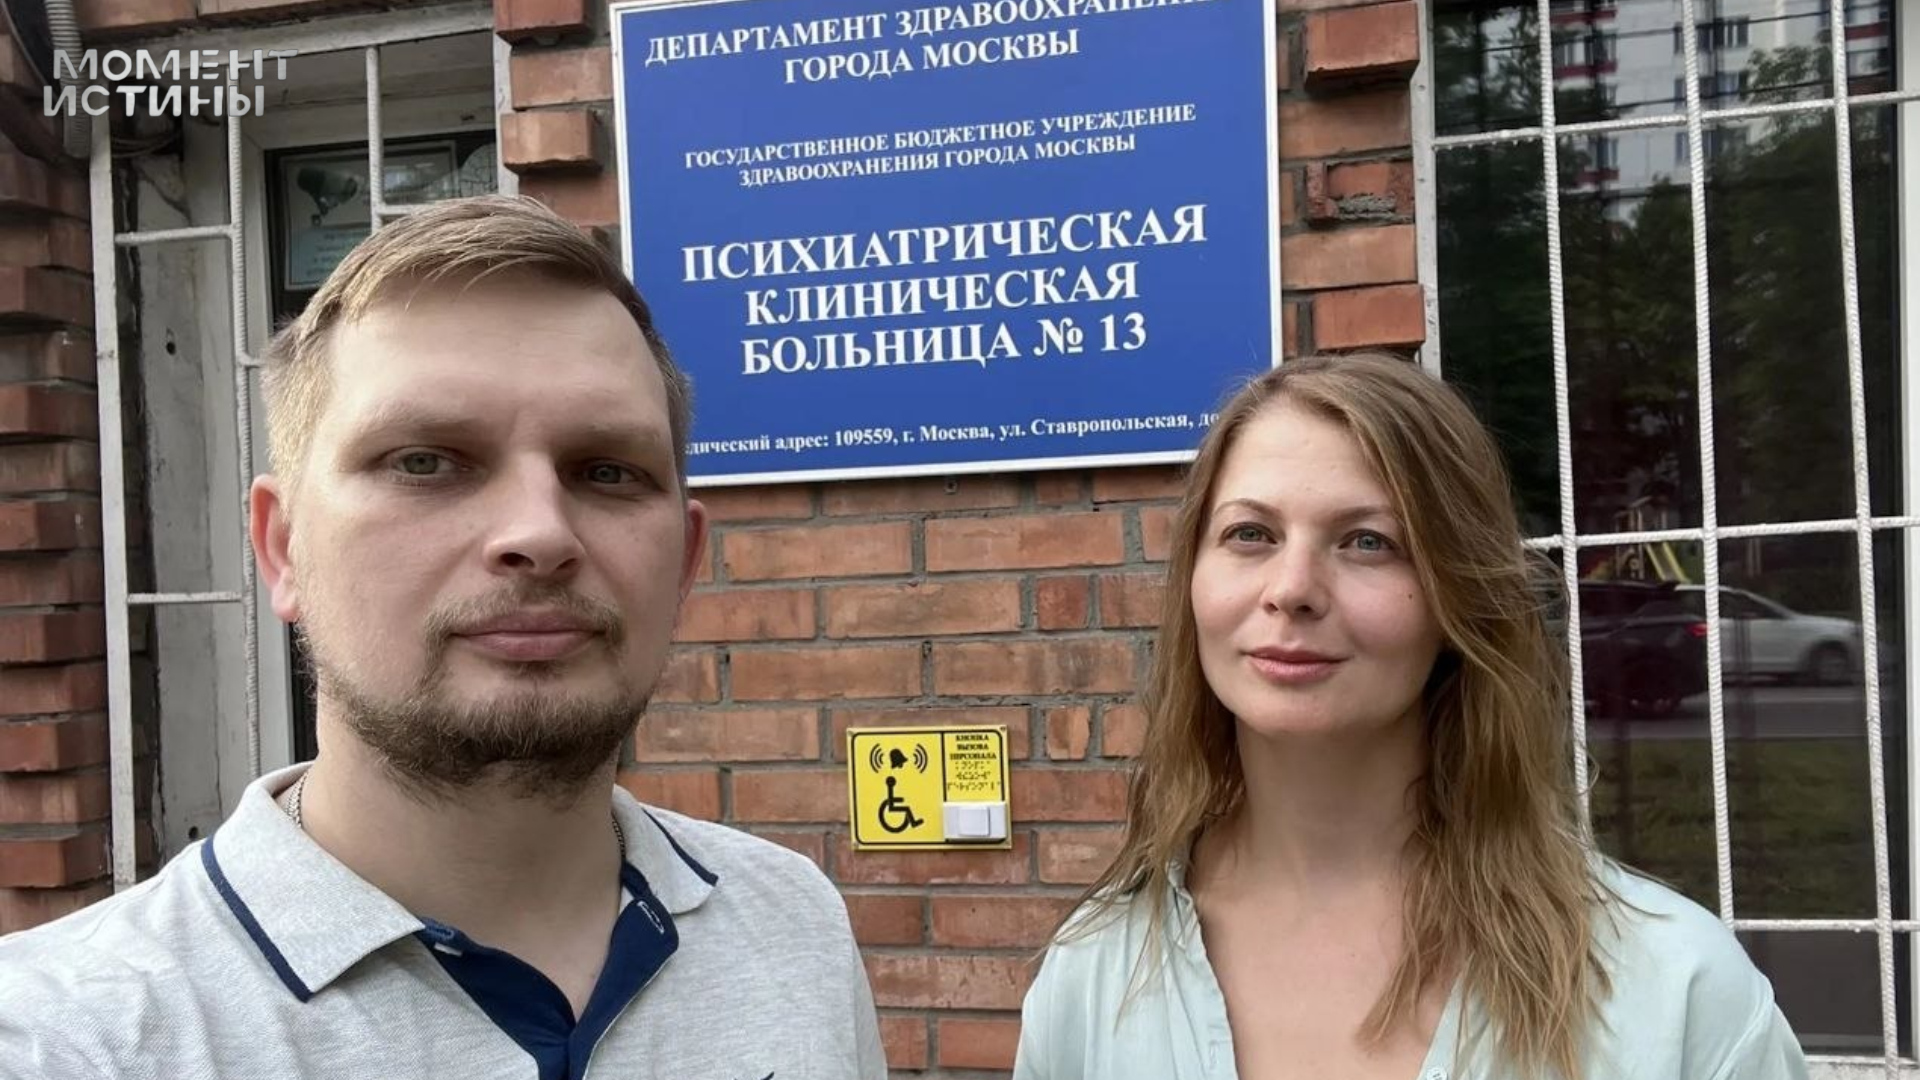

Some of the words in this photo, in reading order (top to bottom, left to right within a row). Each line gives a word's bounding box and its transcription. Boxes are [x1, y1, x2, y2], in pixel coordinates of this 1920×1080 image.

[645, 14, 887, 66] ДЕПАРТАМЕНТ
[784, 48, 913, 84] ГОРОДА
[922, 29, 1080, 70] МОСКВЫ
[685, 133, 888, 169] ГОСУДАРСТВЕННОЕ
[894, 119, 1036, 150] БЮДЖЕТНОЕ
[1041, 104, 1196, 138] УЧРЕЖДЕНИЕ
[738, 152, 940, 187] ЗДРАВООХРАНЕНИЯ
[944, 145, 1029, 171] ГОРОДА
[1034, 134, 1136, 159] МОСКВЫ
[681, 204, 1208, 283] ПСИХИАТРИЧЕСКАЯ
[745, 261, 1140, 326] КЛИНИЧЕСКАЯ
[741, 324, 1020, 375] БОЛЬНИЦА
[1033, 317, 1084, 356] №
[1100, 312, 1147, 352] 13
[684, 435, 770, 455] дический
[774, 435, 829, 453] адрес:
[834, 427, 898, 447] 109559,
[902, 431, 915, 443] г.
[919, 423, 995, 443] Москва,
[999, 424, 1026, 441] ул.
[1030, 411, 1194, 437] Ставропольская,
